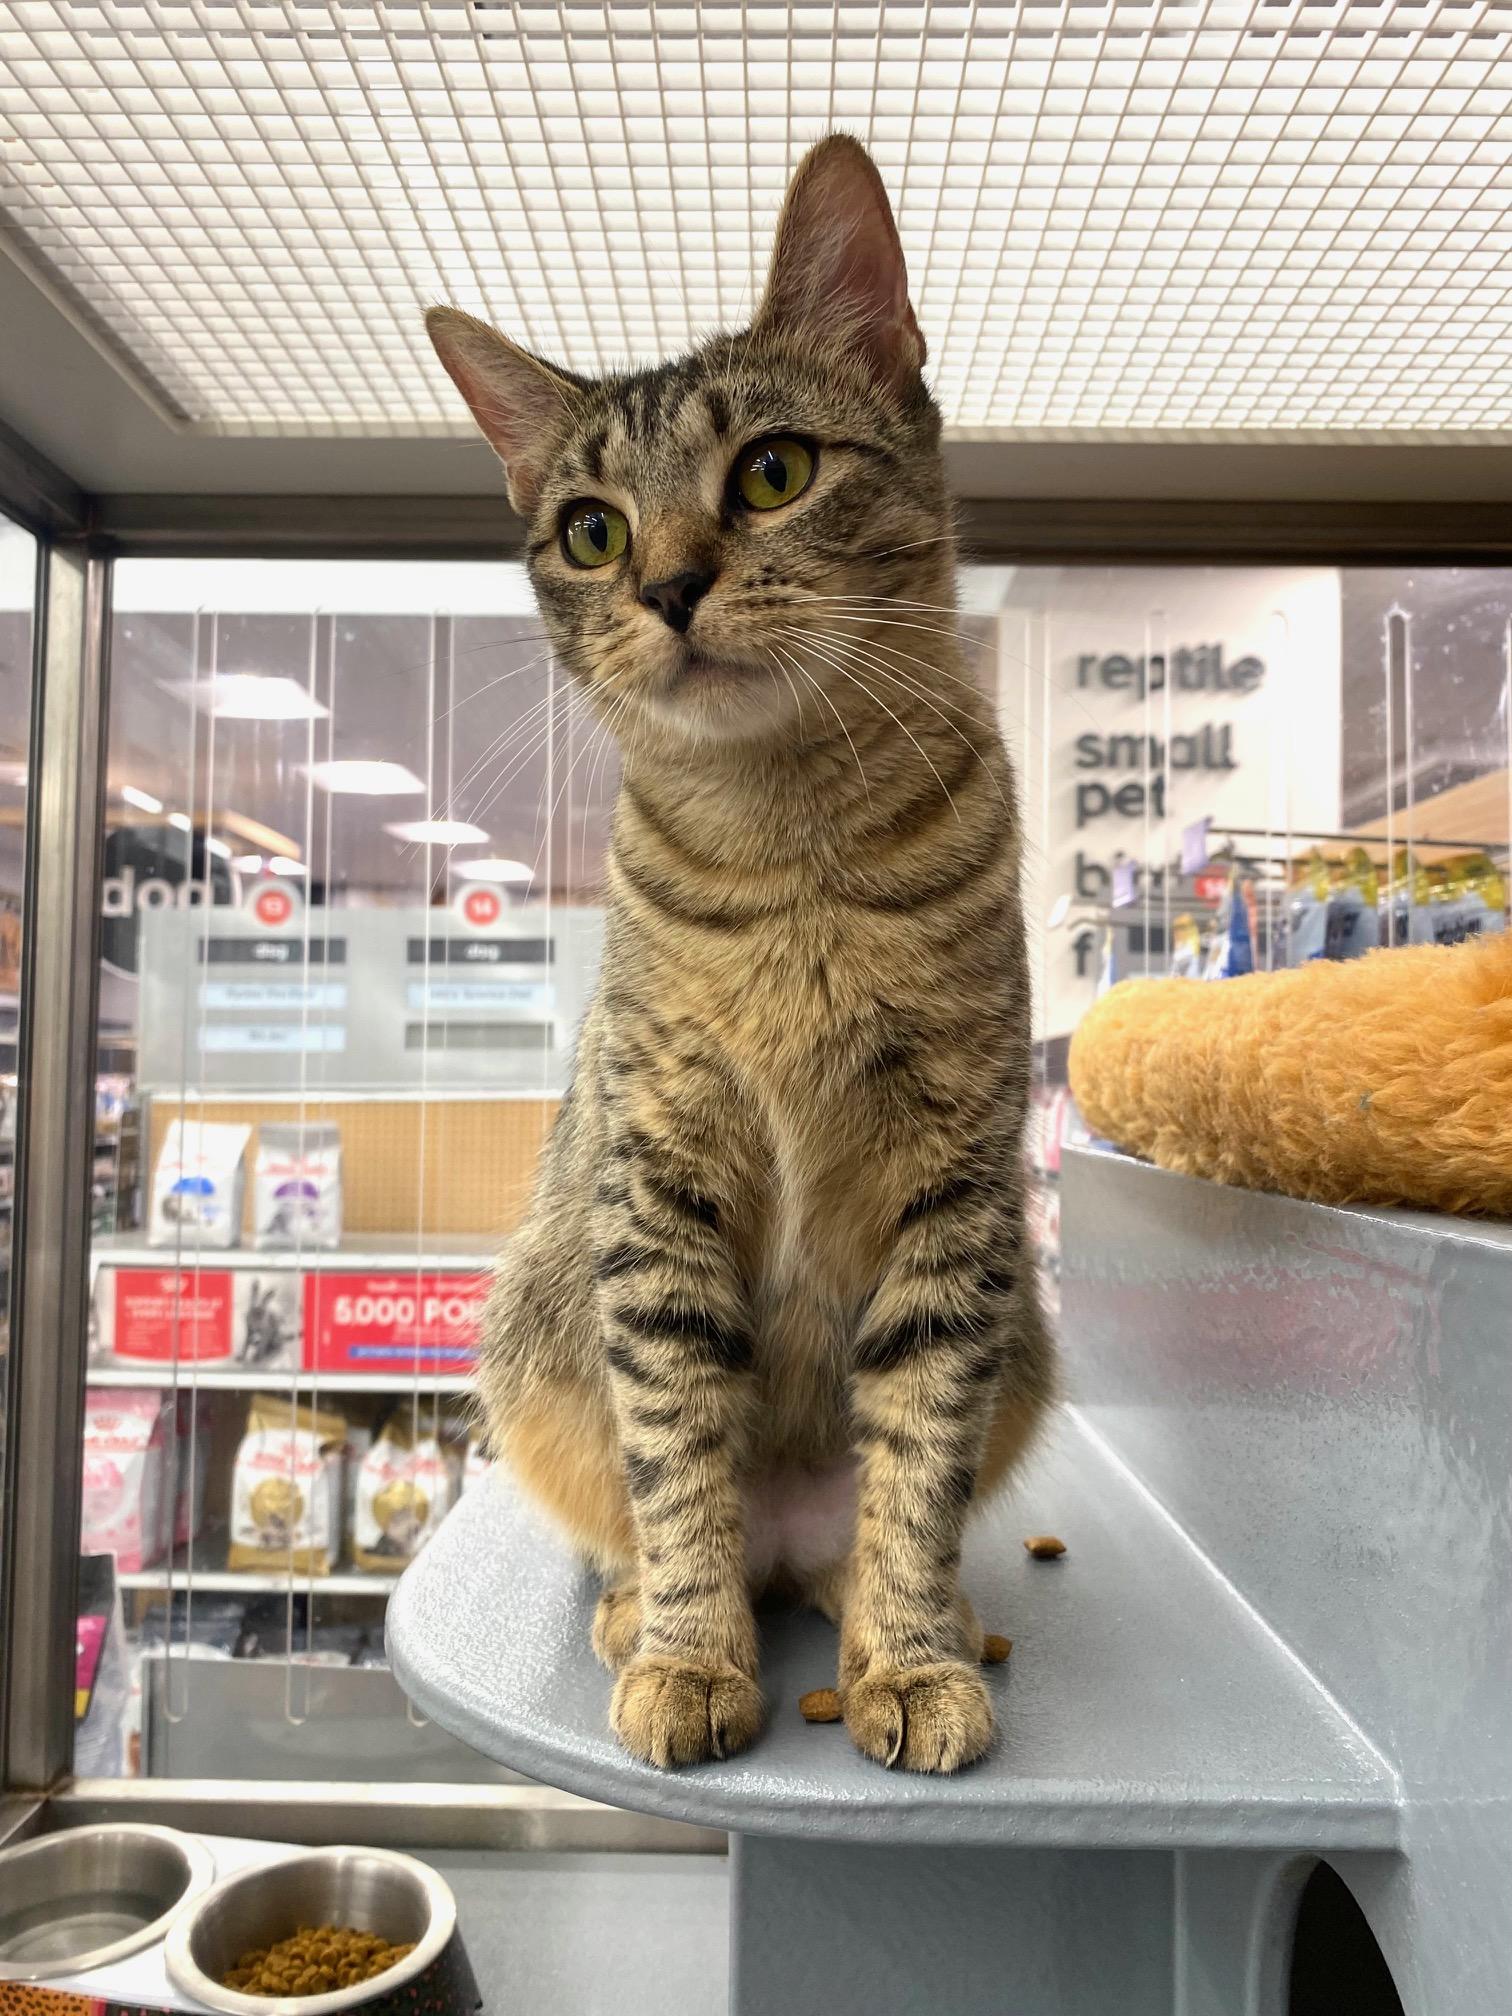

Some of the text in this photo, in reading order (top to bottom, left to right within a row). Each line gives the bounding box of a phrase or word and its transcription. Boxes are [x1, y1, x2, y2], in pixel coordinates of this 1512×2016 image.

[1076, 645, 1265, 702] reptile
[1076, 724, 1239, 769] small
[1076, 775, 1165, 828] pet
